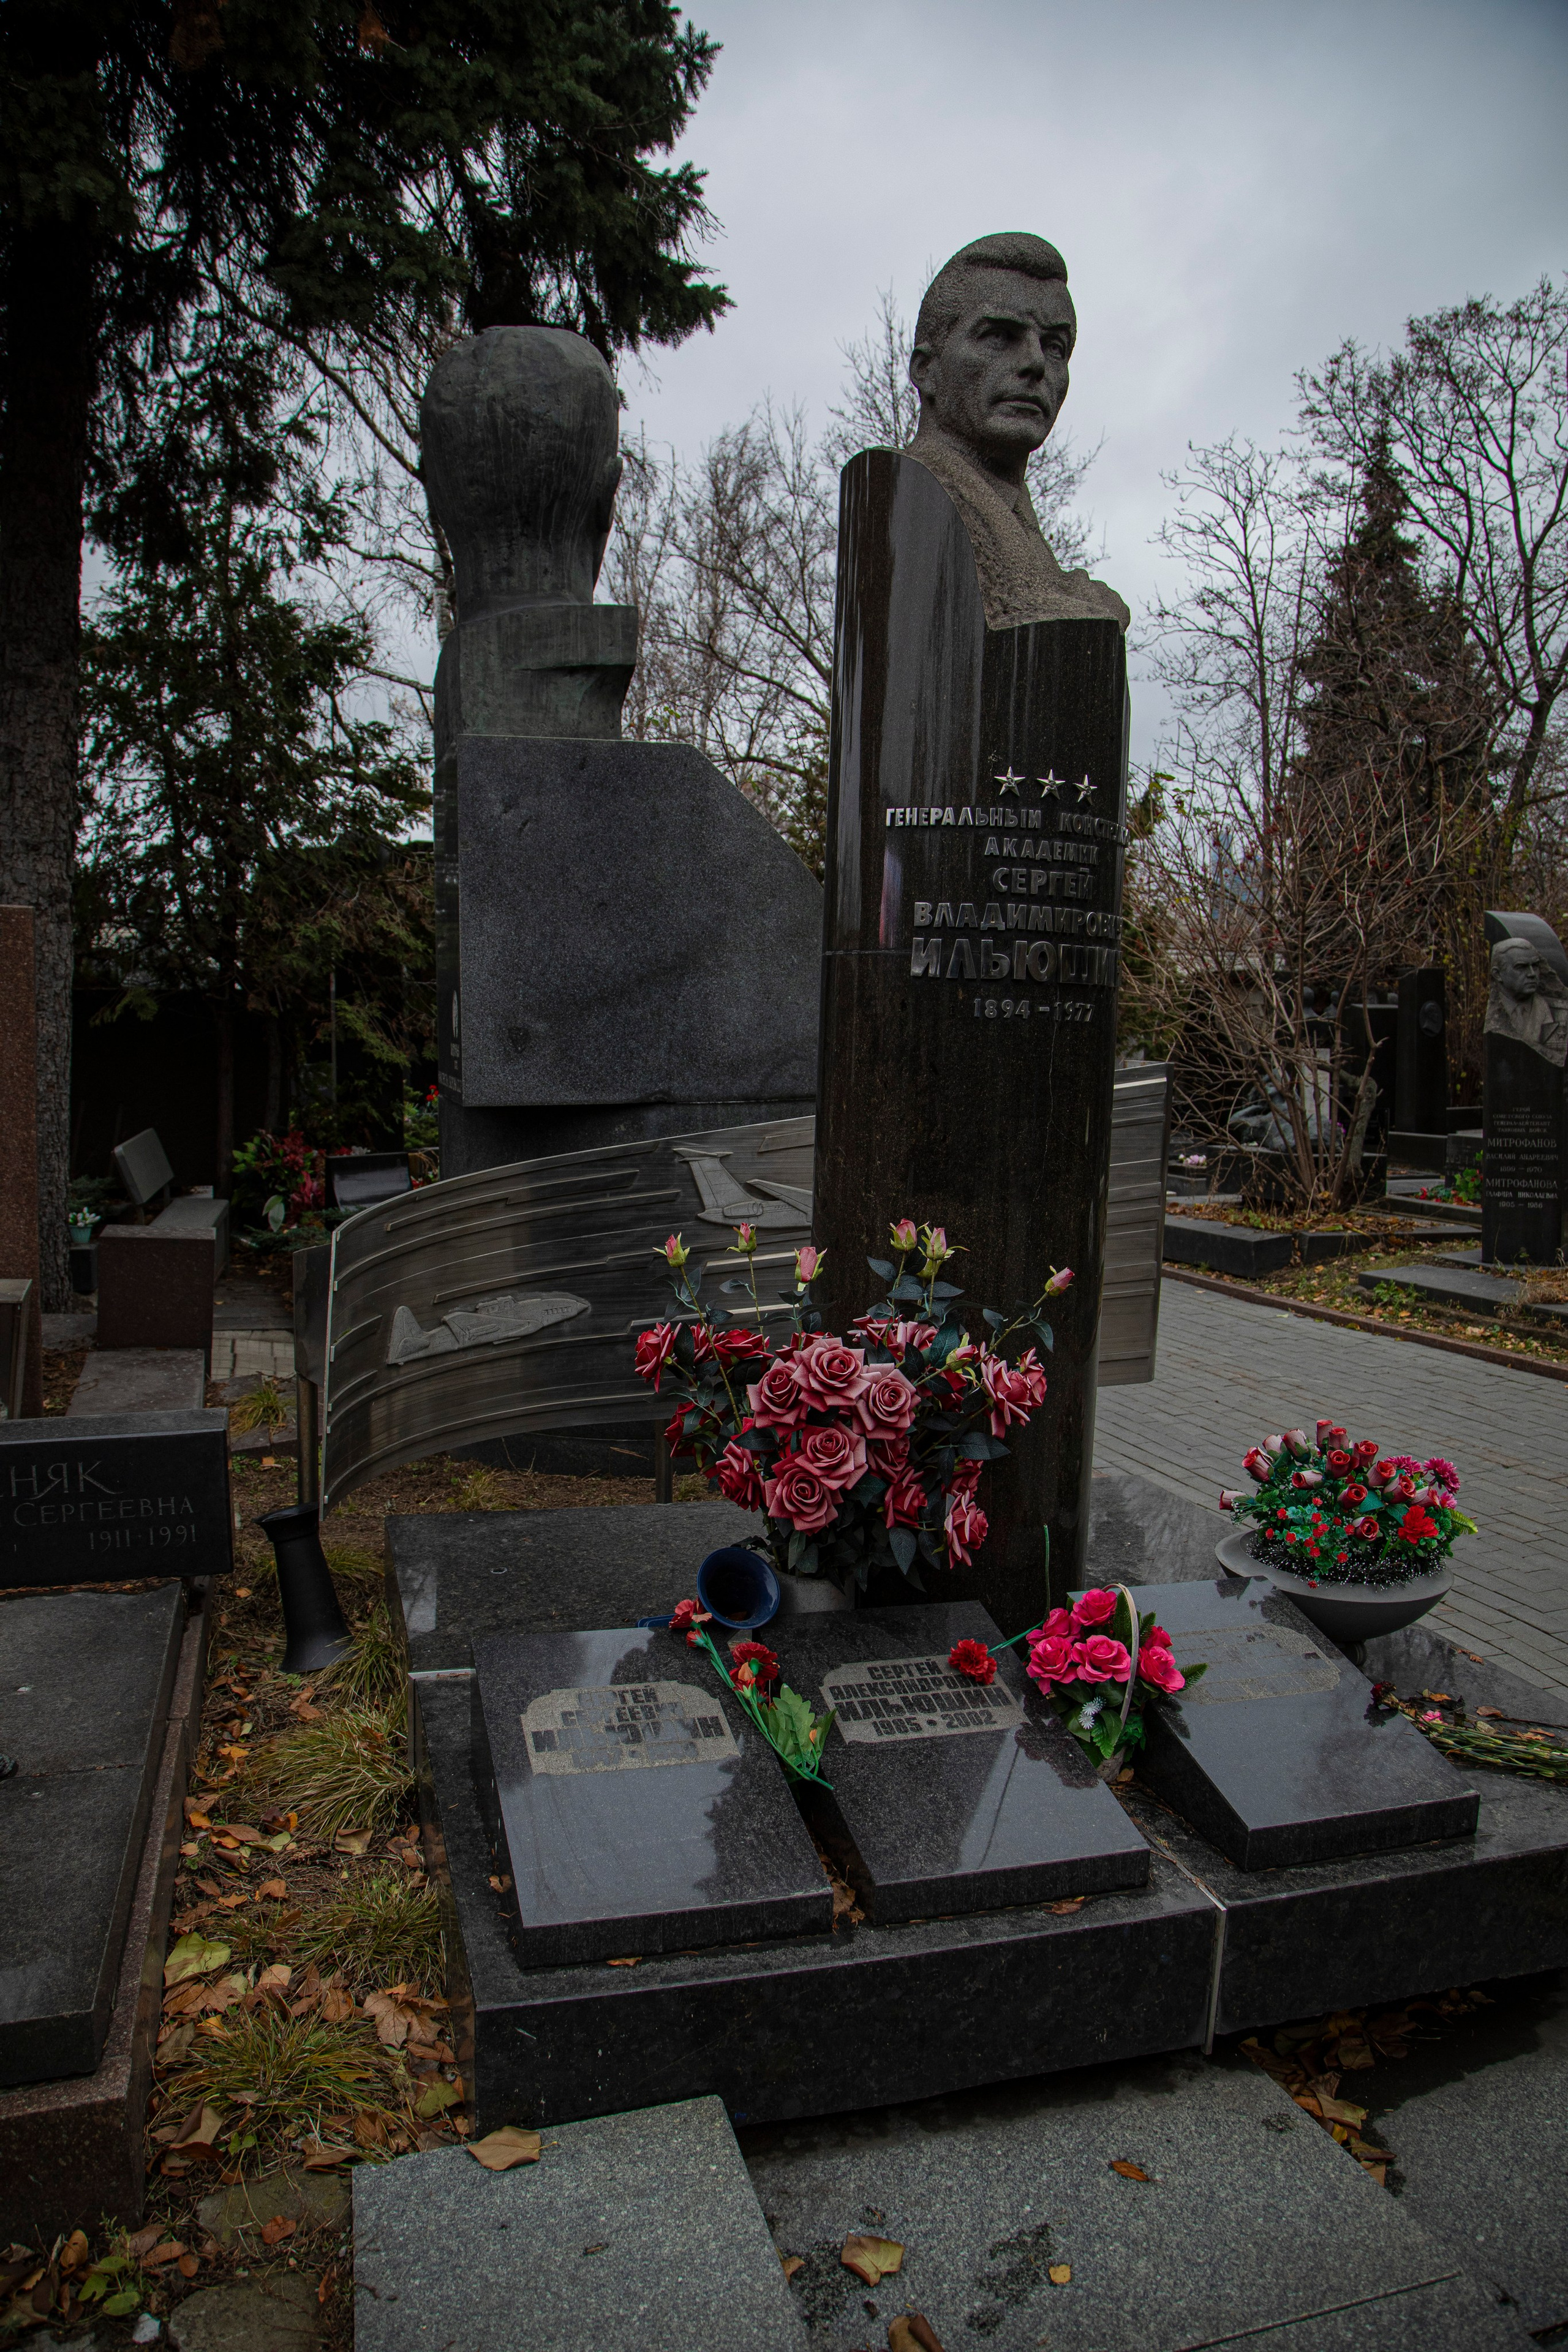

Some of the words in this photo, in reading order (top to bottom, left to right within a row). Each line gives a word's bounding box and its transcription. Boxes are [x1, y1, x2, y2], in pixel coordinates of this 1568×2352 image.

[984, 837, 1099, 865] АКАДЕМИК
[993, 867, 1093, 900] СЕРГЕЙ
[974, 998, 1030, 1019] 1894
[1054, 1001, 1096, 1022] 1977
[1487, 1137, 1558, 1148] МИТРОФАНОВ
[1485, 1177, 1559, 1189] МИТРОФАНОВА
[0, 1460, 125, 1500] НЯК
[867, 1659, 943, 1681] СЕРГЕЙ
[829, 1674, 997, 1701] АЛЕКСАНДРОВ
[834, 1686, 1012, 1722] ИЛЬЮШИН
[872, 1717, 923, 1736] 1985
[940, 1709, 998, 1729] 2002
